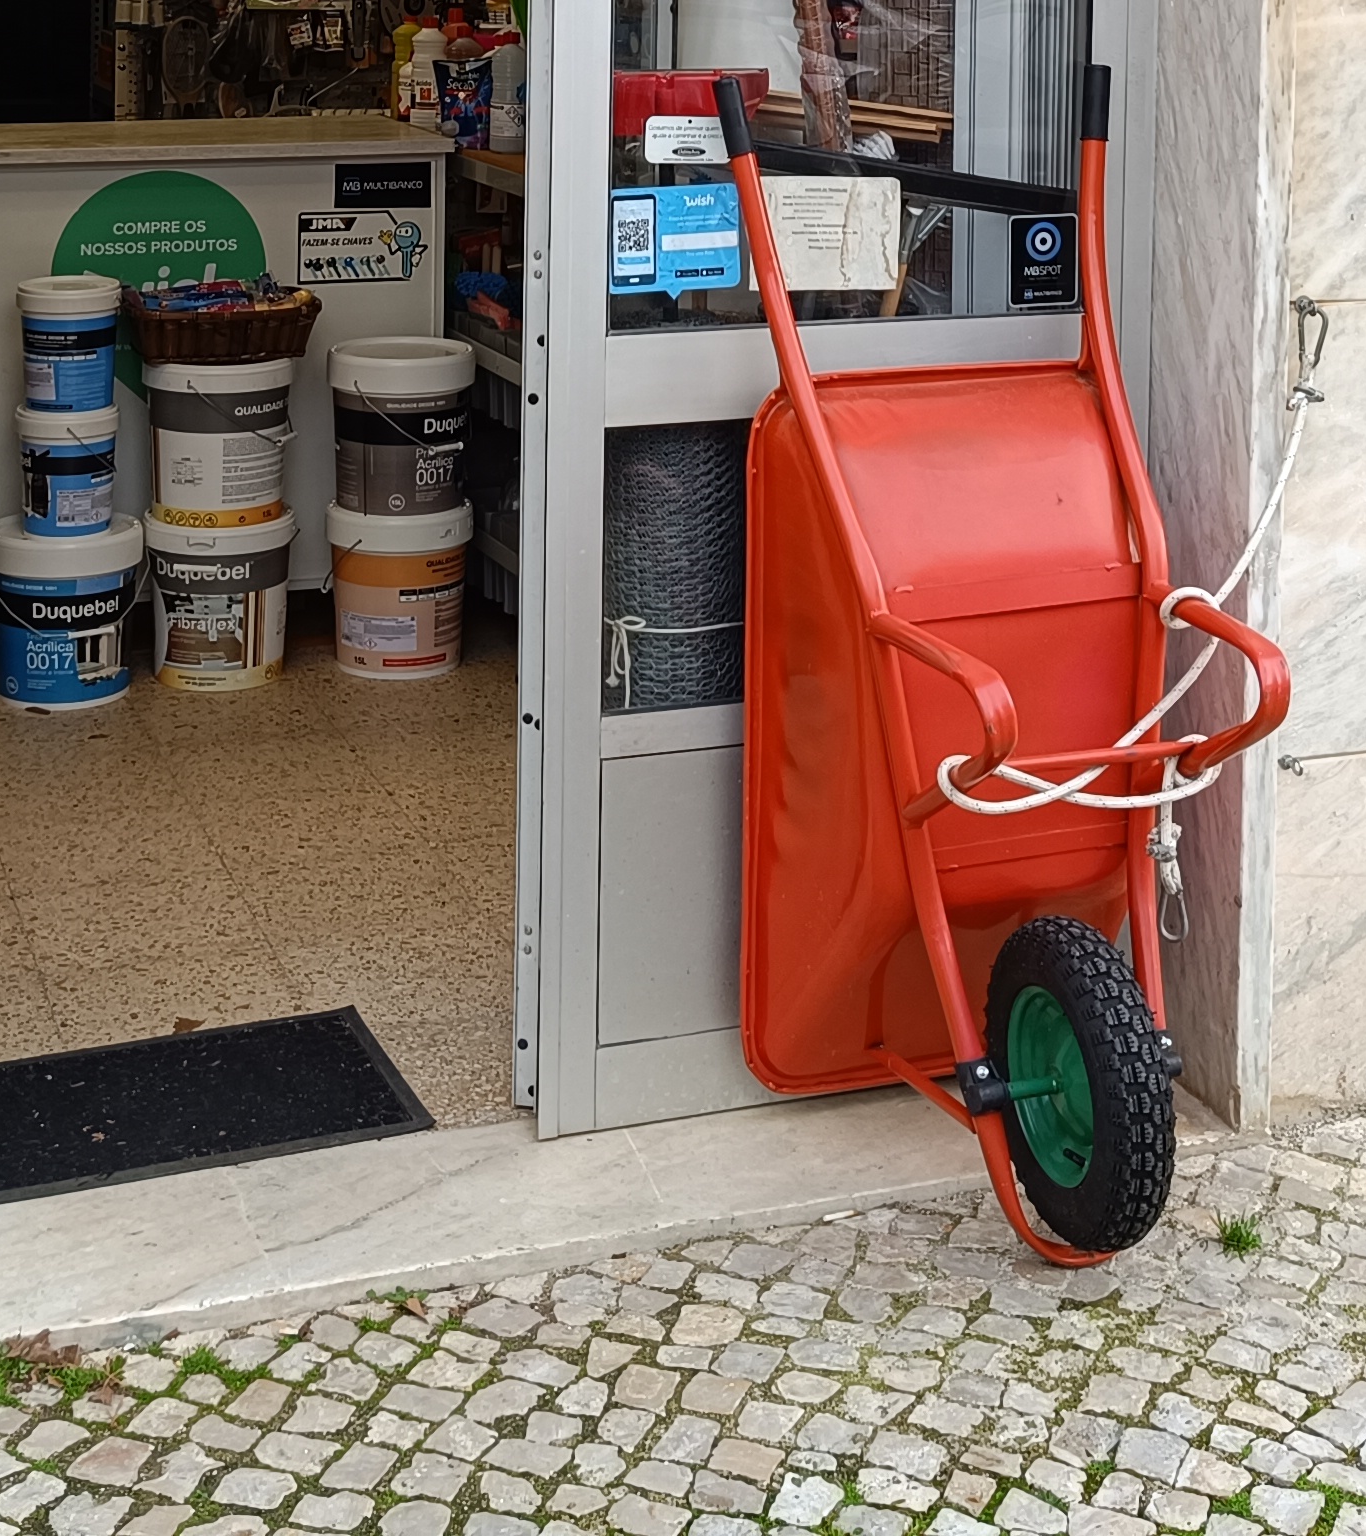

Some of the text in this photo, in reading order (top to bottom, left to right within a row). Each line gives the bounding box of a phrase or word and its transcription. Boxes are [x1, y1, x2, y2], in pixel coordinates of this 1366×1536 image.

[342, 180, 424, 192] MB MULTIBANCO
[683, 194, 715, 207] wish
[112, 220, 206, 235] COMPRE OS
[309, 218, 346, 230] JMA
[80, 239, 238, 256] NOSSOS PRODUTOS
[302, 237, 373, 247] FAZEM-SE CHAVES
[235, 399, 284, 417] QUALIDADE
[416, 465, 454, 485] 0017
[32, 595, 119, 623] Duquebel
[26, 652, 74, 670] 0017
